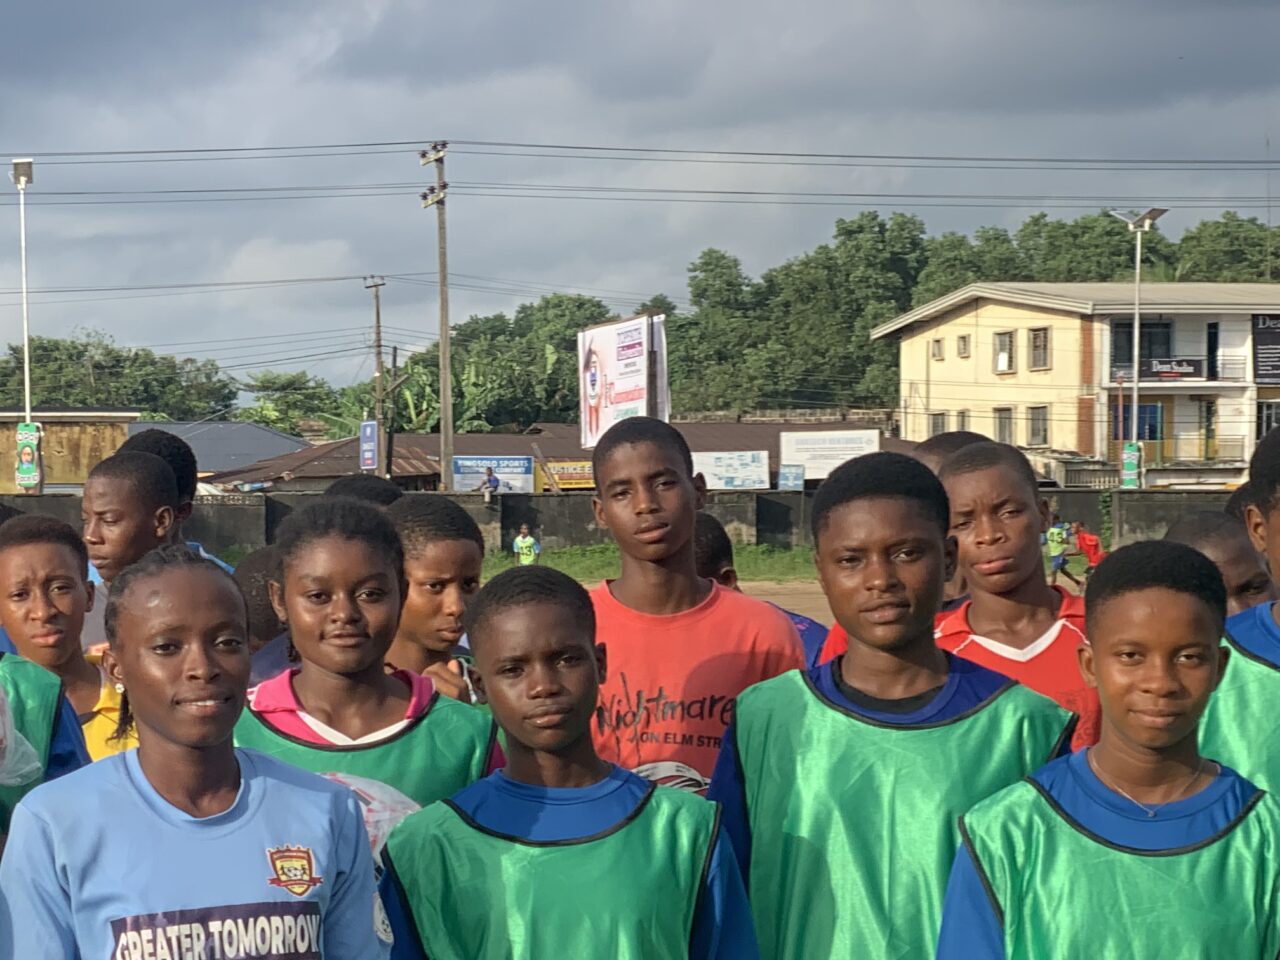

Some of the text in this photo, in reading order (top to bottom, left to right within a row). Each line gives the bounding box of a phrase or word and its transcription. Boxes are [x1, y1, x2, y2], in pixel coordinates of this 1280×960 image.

[499, 460, 528, 468] SPORTS
[640, 731, 660, 744] ON
[664, 732, 693, 747] ELM
